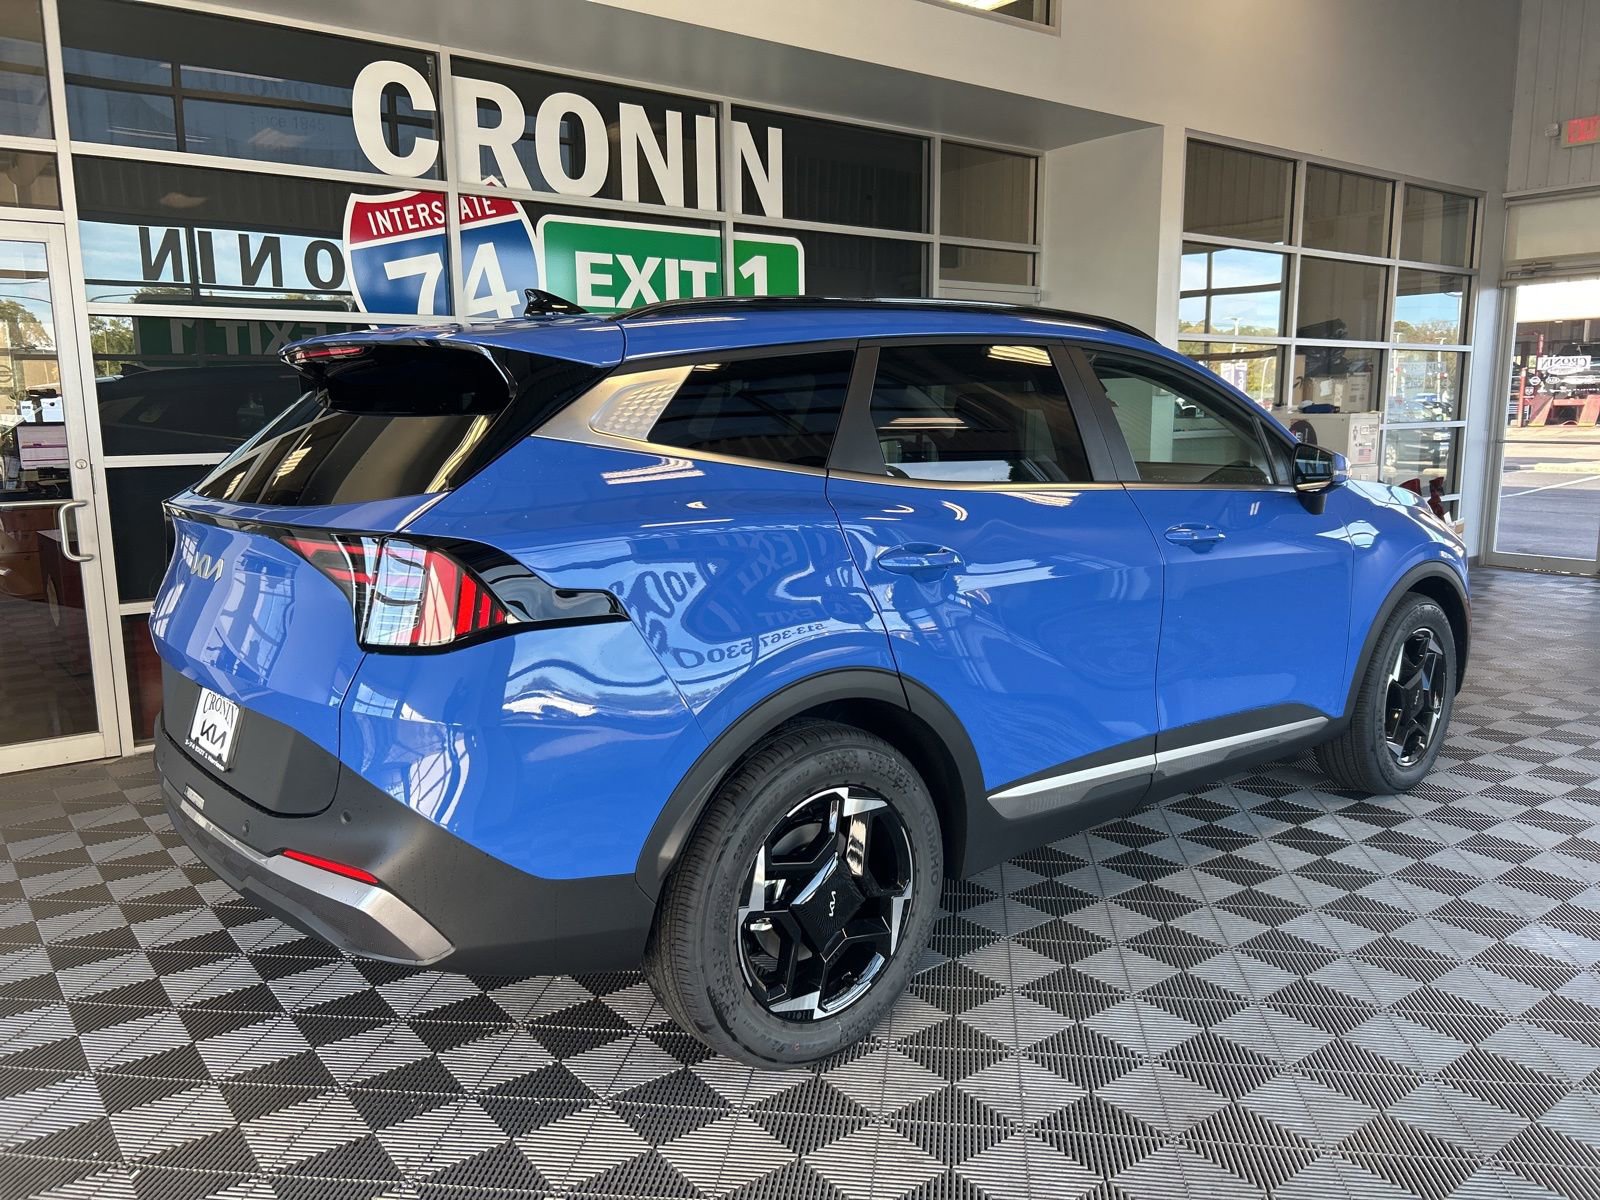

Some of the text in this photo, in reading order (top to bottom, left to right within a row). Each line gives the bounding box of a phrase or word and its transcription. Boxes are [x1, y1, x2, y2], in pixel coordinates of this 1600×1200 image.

[352, 60, 784, 219] CRONIN
[367, 197, 497, 236] INTERSATE
[383, 242, 521, 319] 74
[575, 251, 768, 308] EXIT 1
[190, 551, 225, 582] KIA
[200, 719, 227, 750] KIA
[203, 691, 238, 730] CRONIN
[920, 808, 939, 886] KUMHO
